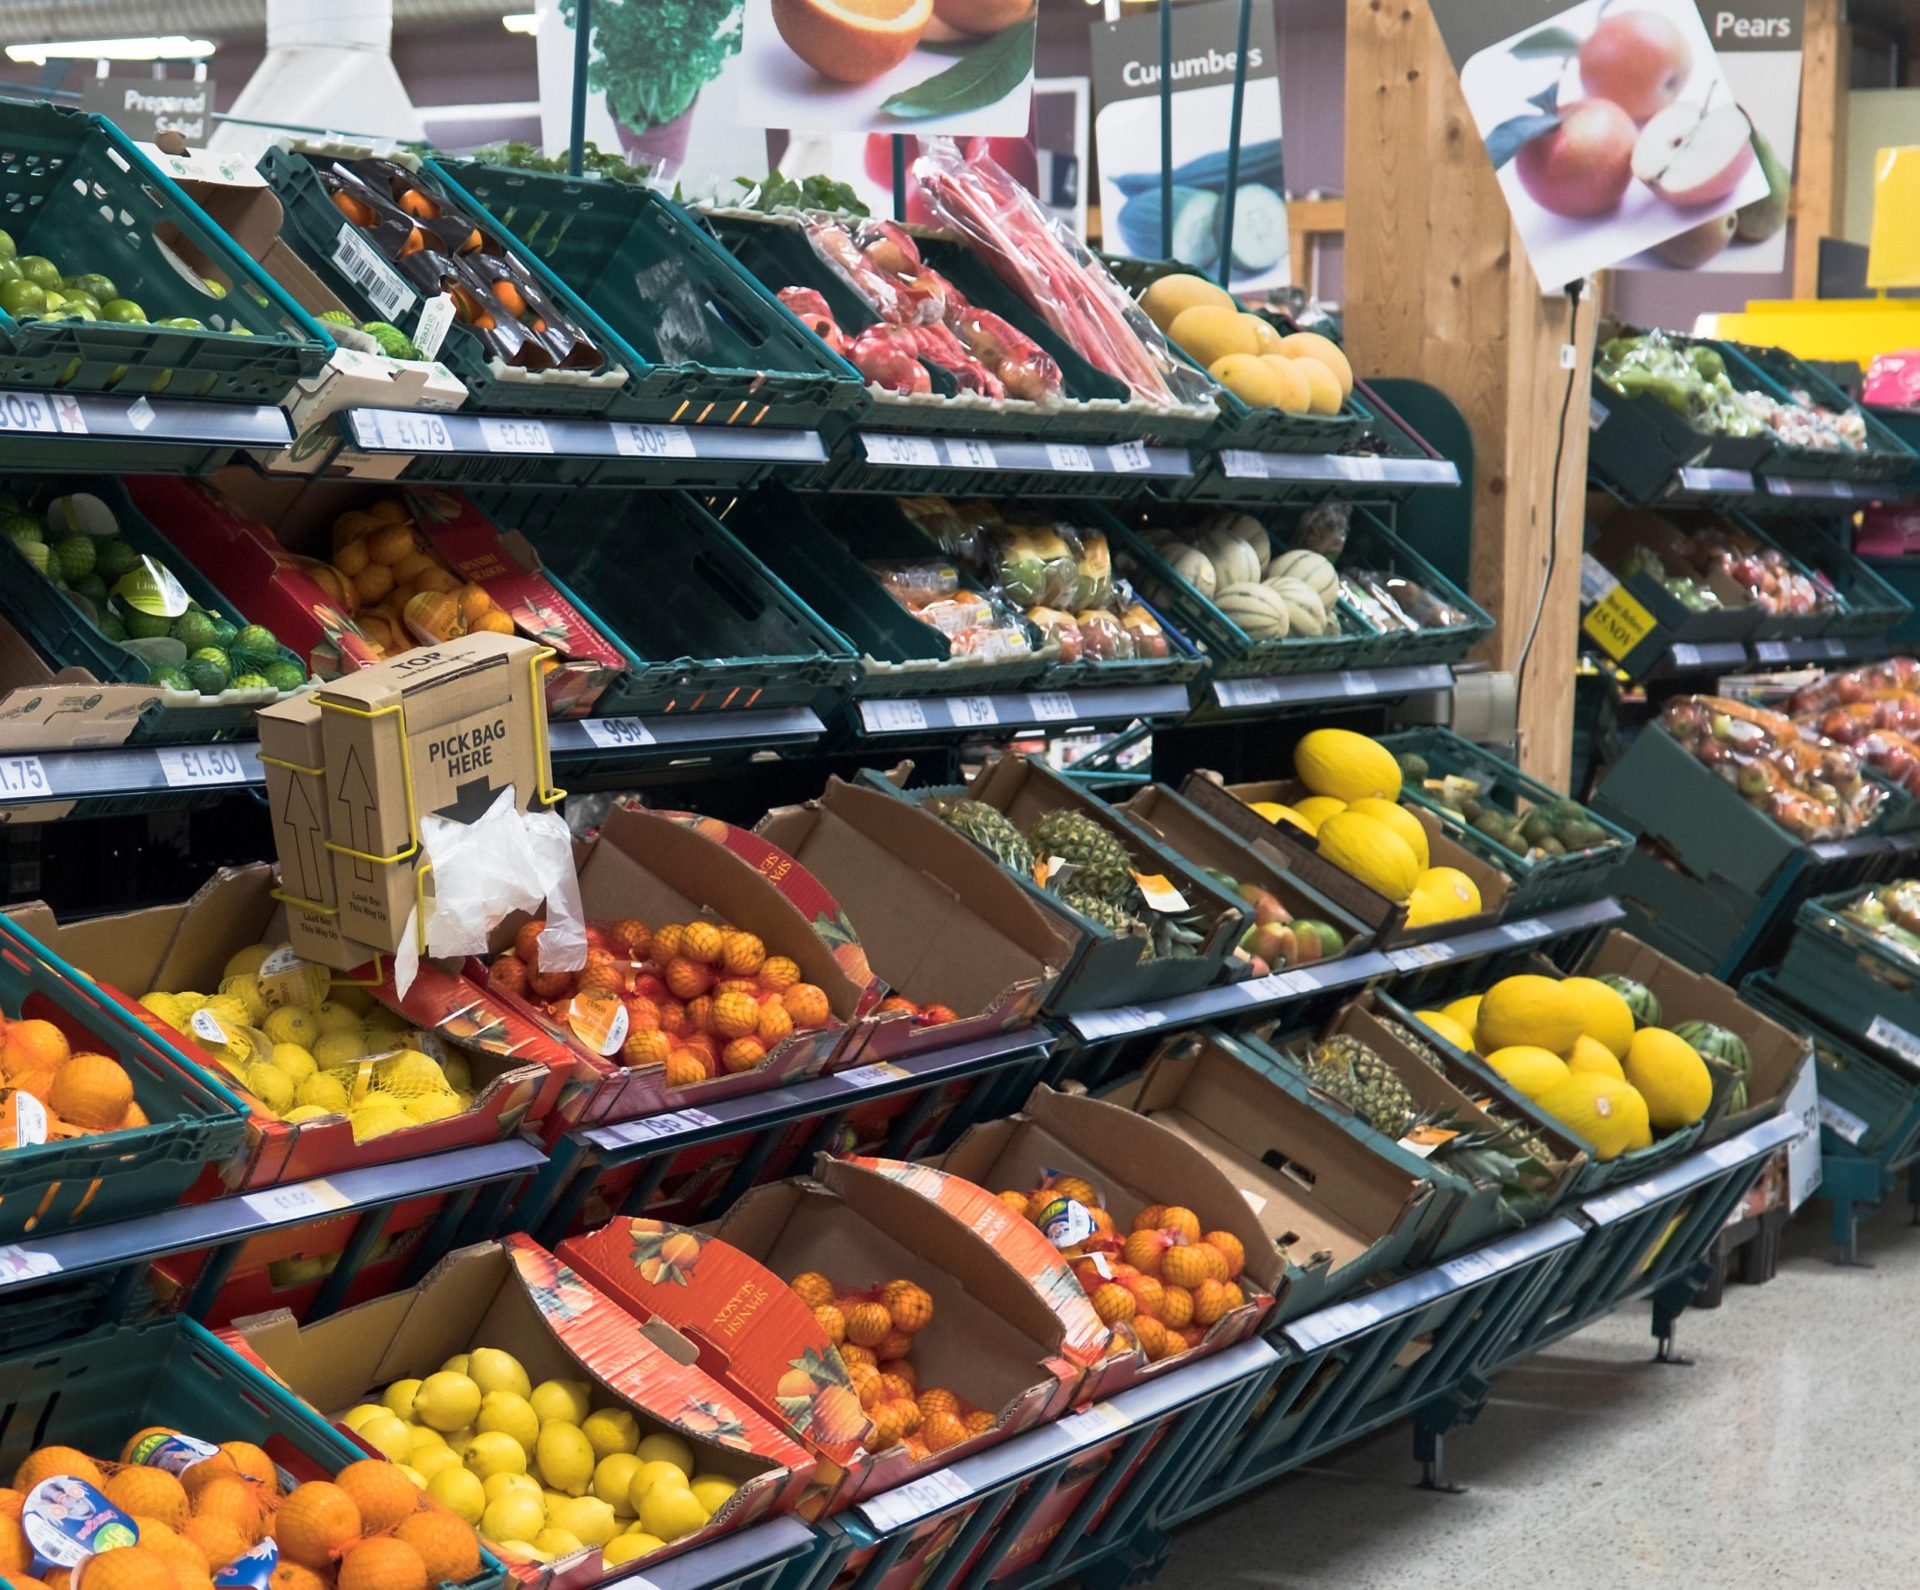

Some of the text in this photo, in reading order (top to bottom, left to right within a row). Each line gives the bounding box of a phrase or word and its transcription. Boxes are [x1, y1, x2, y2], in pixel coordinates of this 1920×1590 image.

[1715, 11, 1791, 38] Pears
[1122, 47, 1263, 88] Cuumbes
[124, 88, 206, 115] Prepared
[398, 419, 446, 446] £1.79
[499, 423, 546, 448] £2.50
[629, 425, 667, 454] 50p
[887, 435, 918, 462] 90p
[965, 440, 986, 465] £1
[1122, 442, 1143, 467] £3
[1593, 608, 1631, 646] 15 NOV
[390, 652, 441, 670] TOP
[961, 698, 989, 723] 79p
[428, 719, 506, 763] PICK BAG
[602, 719, 642, 744] 99p
[181, 748, 237, 777] £1.50
[447, 745, 493, 778] HERE
[348, 901, 387, 922] This Way Up
[300, 922, 314, 934] This
[631, 1118, 682, 1137] 79p
[712, 1279, 756, 1325] SEASON
[723, 1287, 769, 1338] SPANISH
[894, 1485, 940, 1515] 79p
